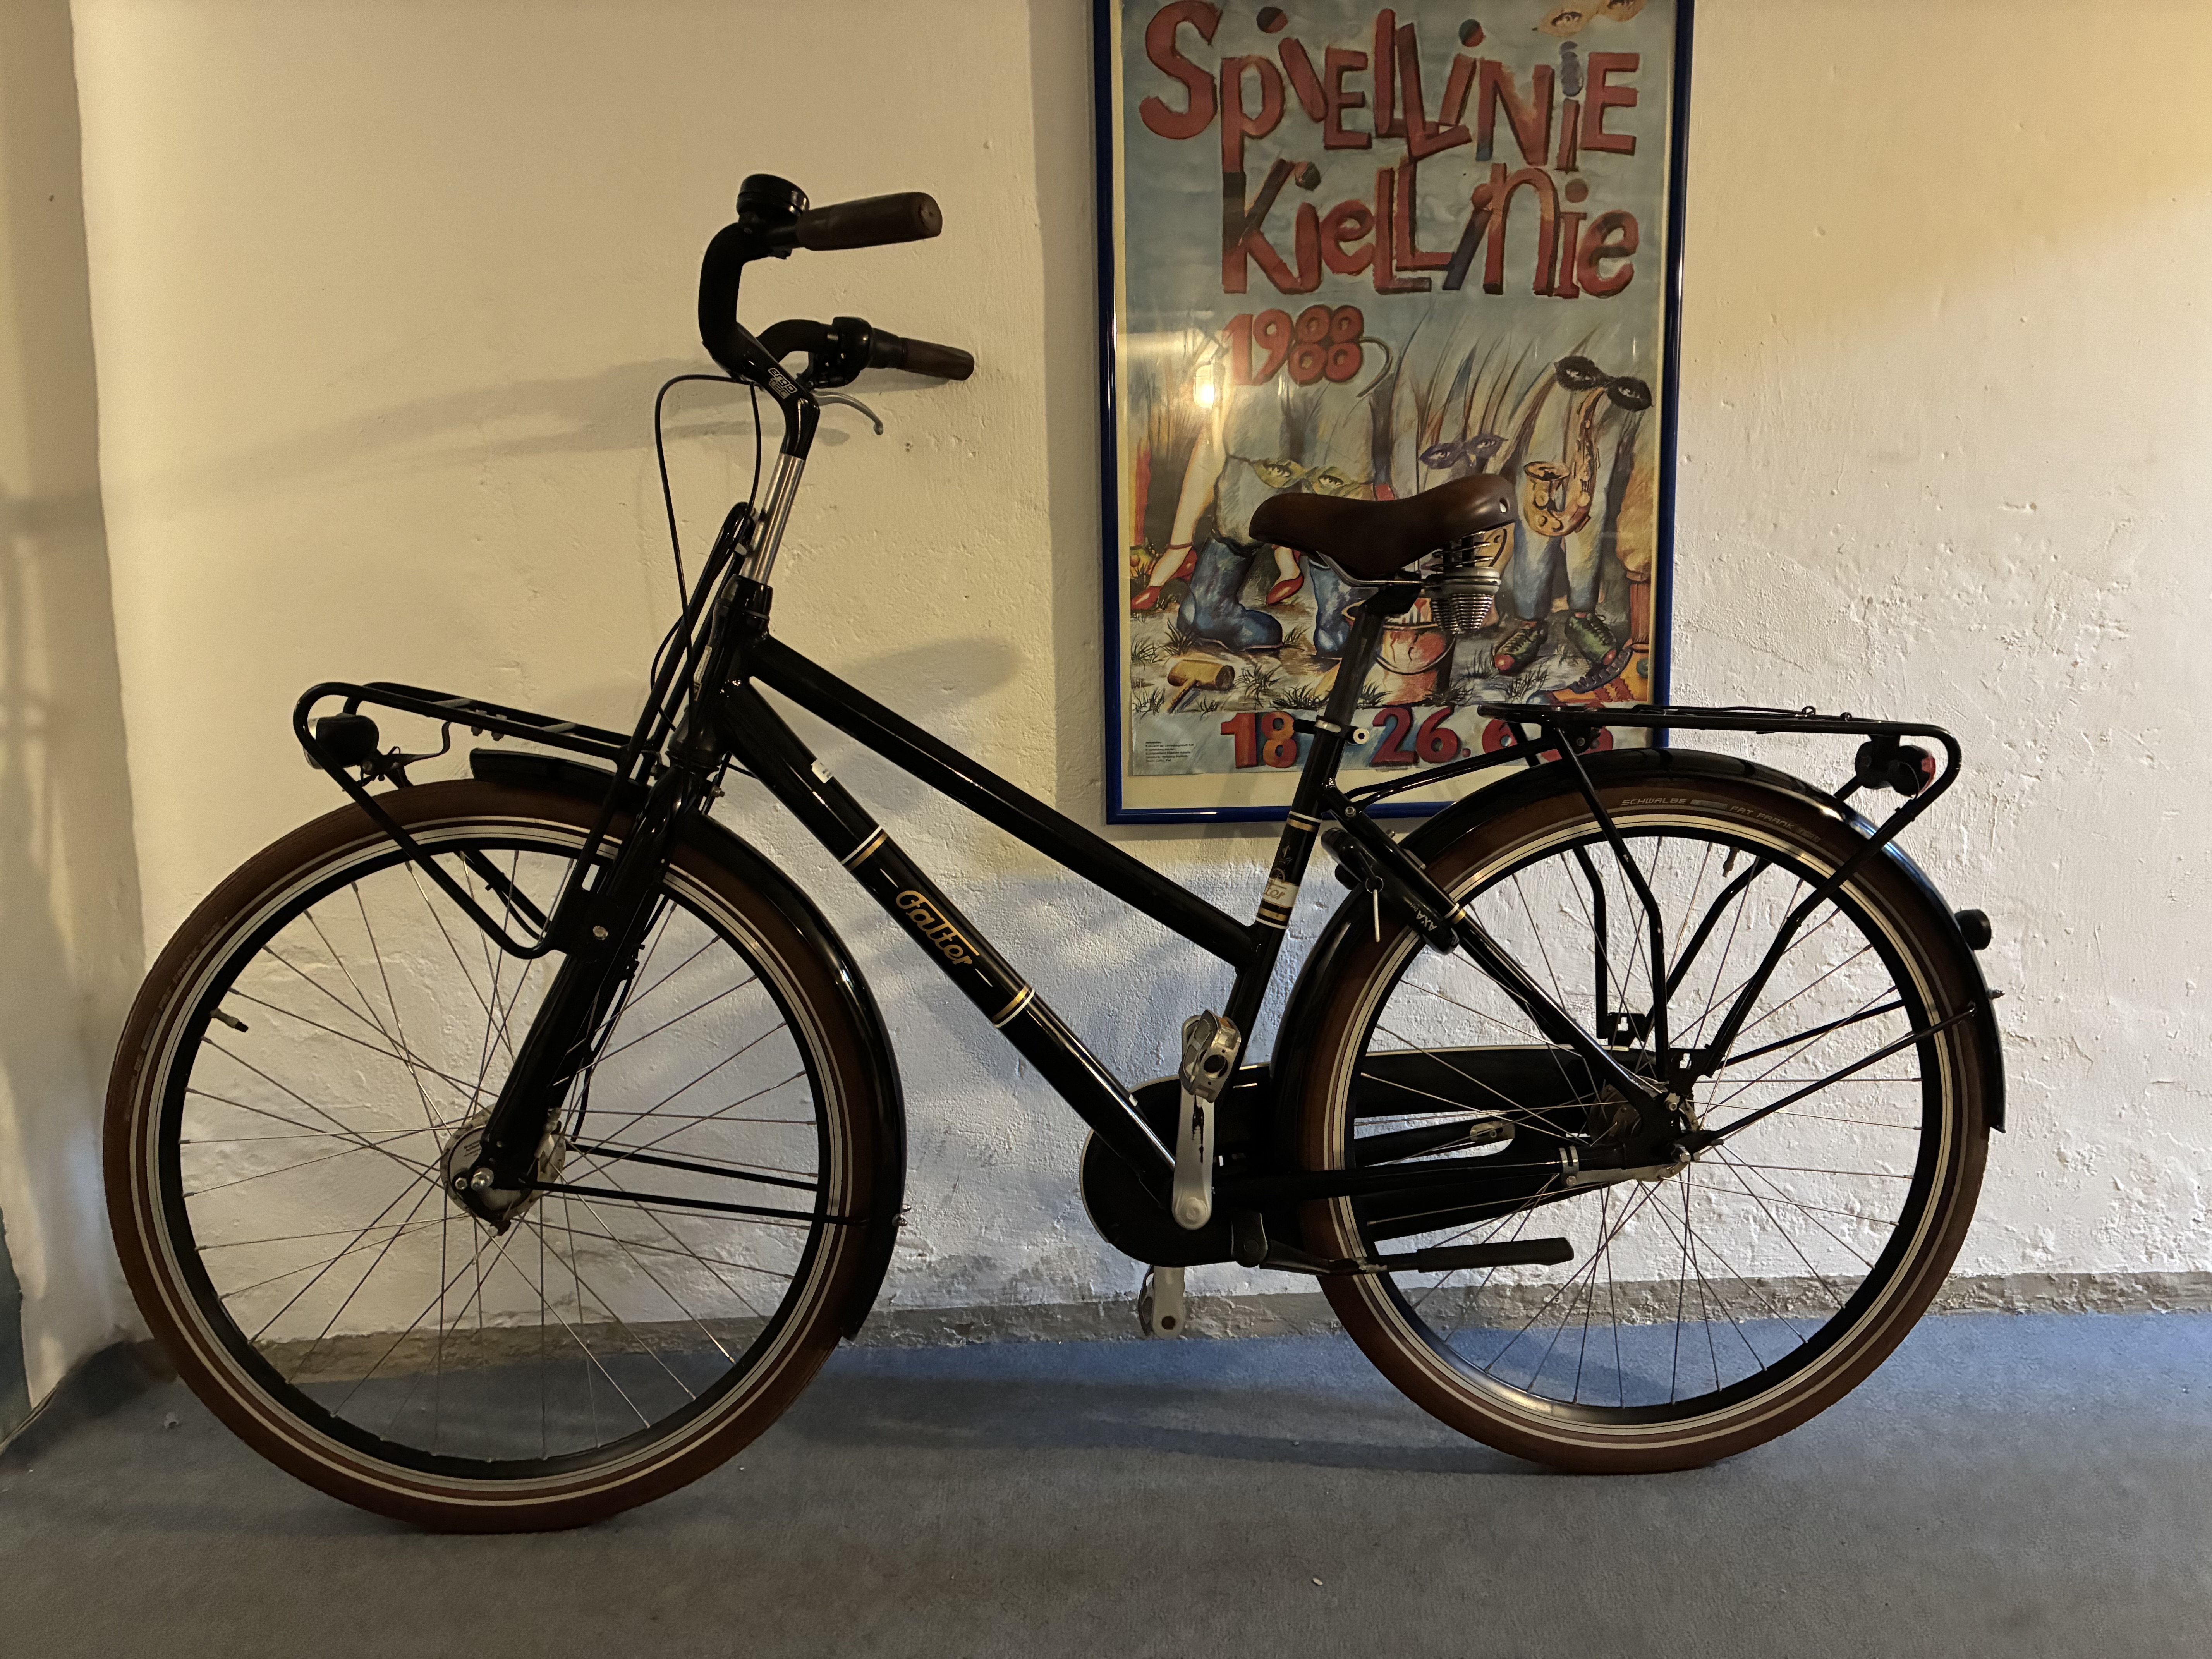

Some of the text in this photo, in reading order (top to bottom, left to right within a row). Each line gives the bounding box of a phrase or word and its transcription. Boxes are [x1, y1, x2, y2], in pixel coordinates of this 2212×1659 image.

[1222, 304, 1364, 386] 1988
[768, 368, 798, 394] ergo
[1621, 797, 1795, 830] SCHWALBE FAT FRANK
[895, 890, 980, 965] Falter
[1416, 910, 1437, 931] AXA
